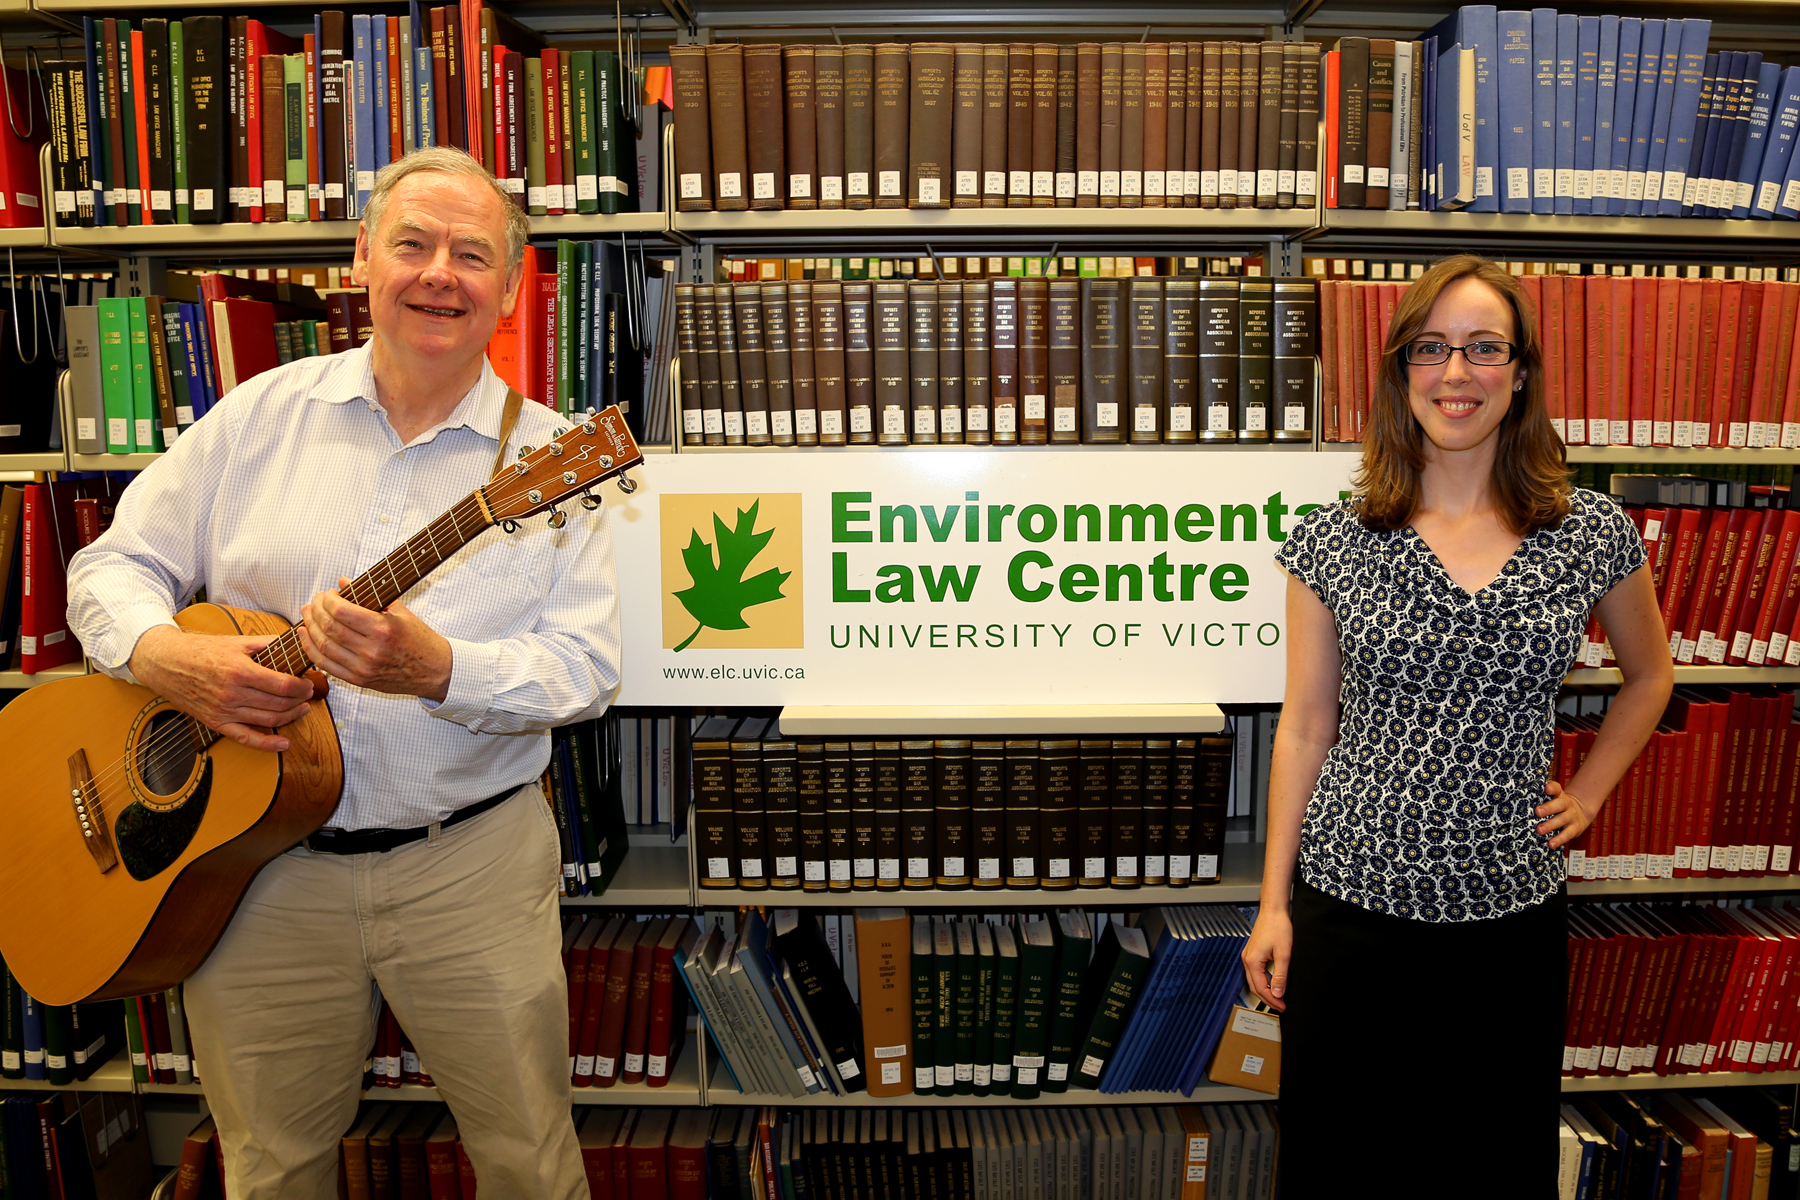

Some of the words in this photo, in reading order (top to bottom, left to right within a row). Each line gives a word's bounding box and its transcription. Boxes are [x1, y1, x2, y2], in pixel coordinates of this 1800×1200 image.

[75, 70, 83, 79] THE
[420, 83, 429, 95] The
[75, 80, 86, 122] SUCCESSFUL
[421, 97, 430, 123] Business
[1751, 112, 1769, 120] MEETING
[1463, 123, 1471, 132] of
[1750, 119, 1766, 127] PAPERS
[78, 125, 88, 139] LAW
[80, 140, 89, 156] FIRM
[1462, 155, 1470, 177] LAW
[547, 298, 555, 312] THE
[832, 491, 1352, 542] Environment
[832, 551, 981, 603] Law
[1007, 550, 1250, 603] Centre
[831, 623, 1072, 649] UNIVERSITY
[1093, 622, 1142, 648] OF
[1162, 622, 1281, 647] VICTO
[662, 665, 806, 681] www.elc.uvic.ca
